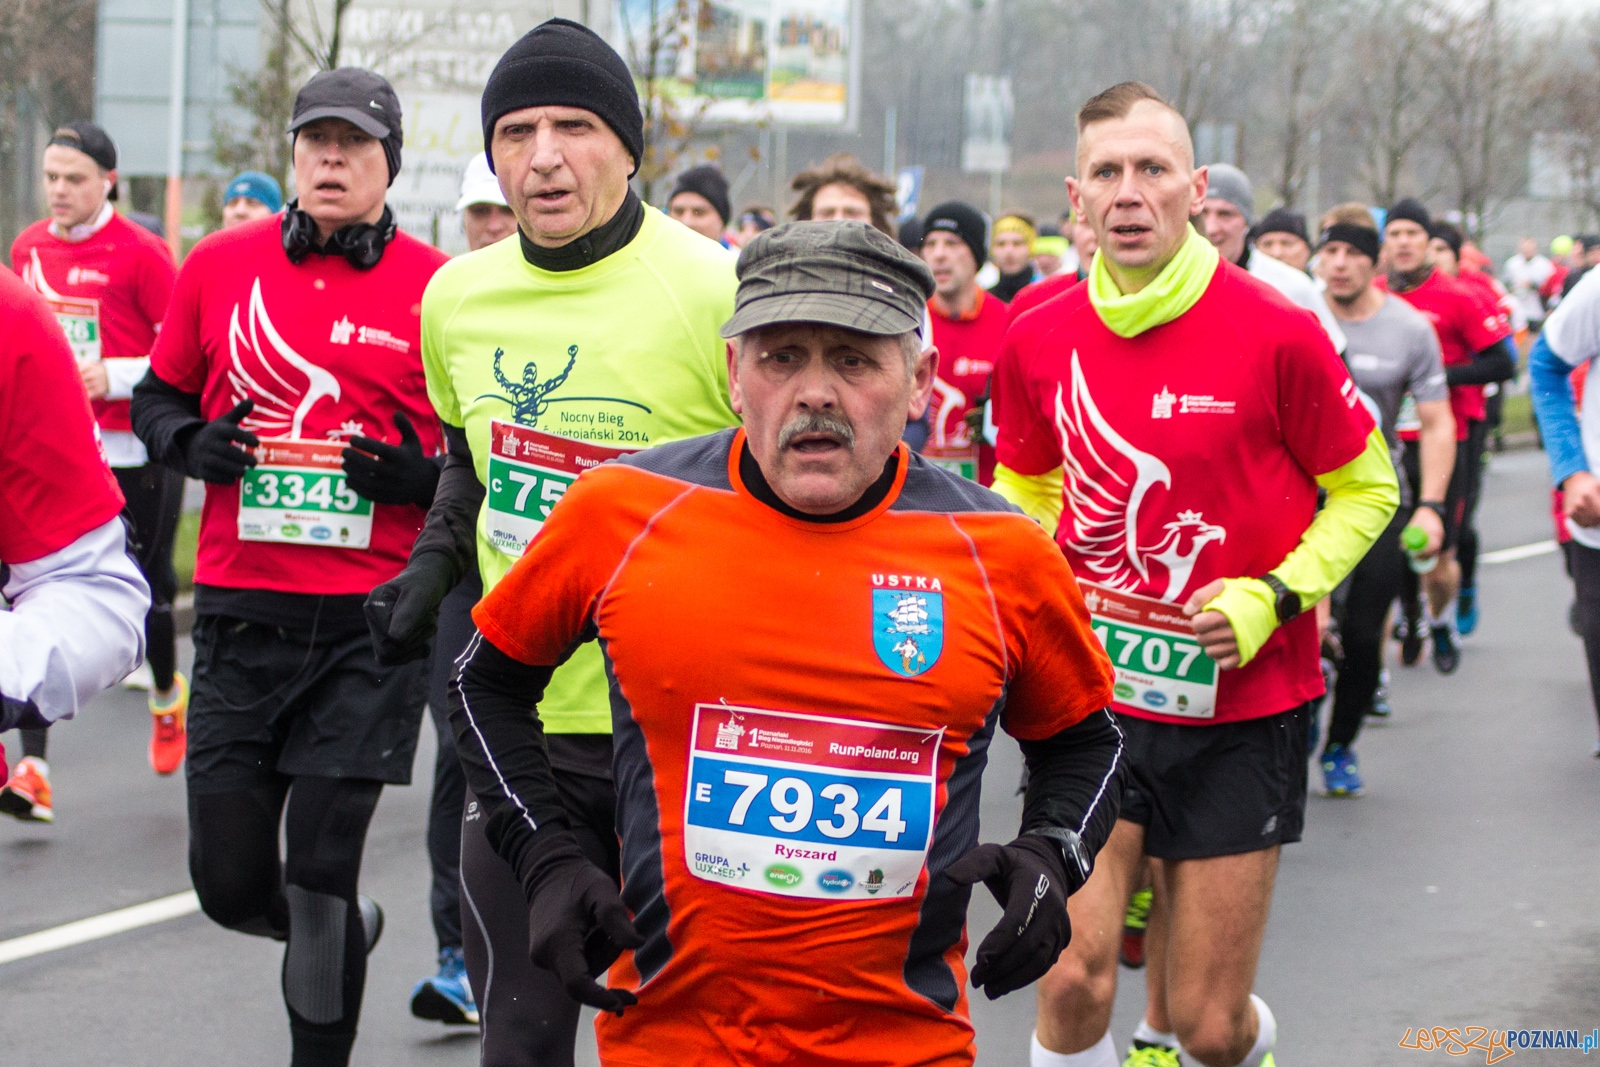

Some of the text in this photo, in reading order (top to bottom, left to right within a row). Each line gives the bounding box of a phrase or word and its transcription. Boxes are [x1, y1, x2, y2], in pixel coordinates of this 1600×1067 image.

[60, 319, 91, 342] 26
[1179, 394, 1189, 413] 1
[560, 411, 624, 427] Nocny Bieg
[618, 430, 649, 442] 2014
[575, 455, 602, 468] RunP
[256, 473, 359, 512] 3345
[508, 470, 568, 518] 75
[871, 573, 942, 591] USTKA
[1094, 625, 1202, 678] 1707
[748, 727, 789, 748] 1 Poznański
[758, 734, 772, 743] Bieg
[829, 742, 920, 765] RunPoland.org
[695, 769, 907, 843] E 7934
[694, 852, 730, 868] GRUPA
[775, 844, 837, 861] Ryszard
